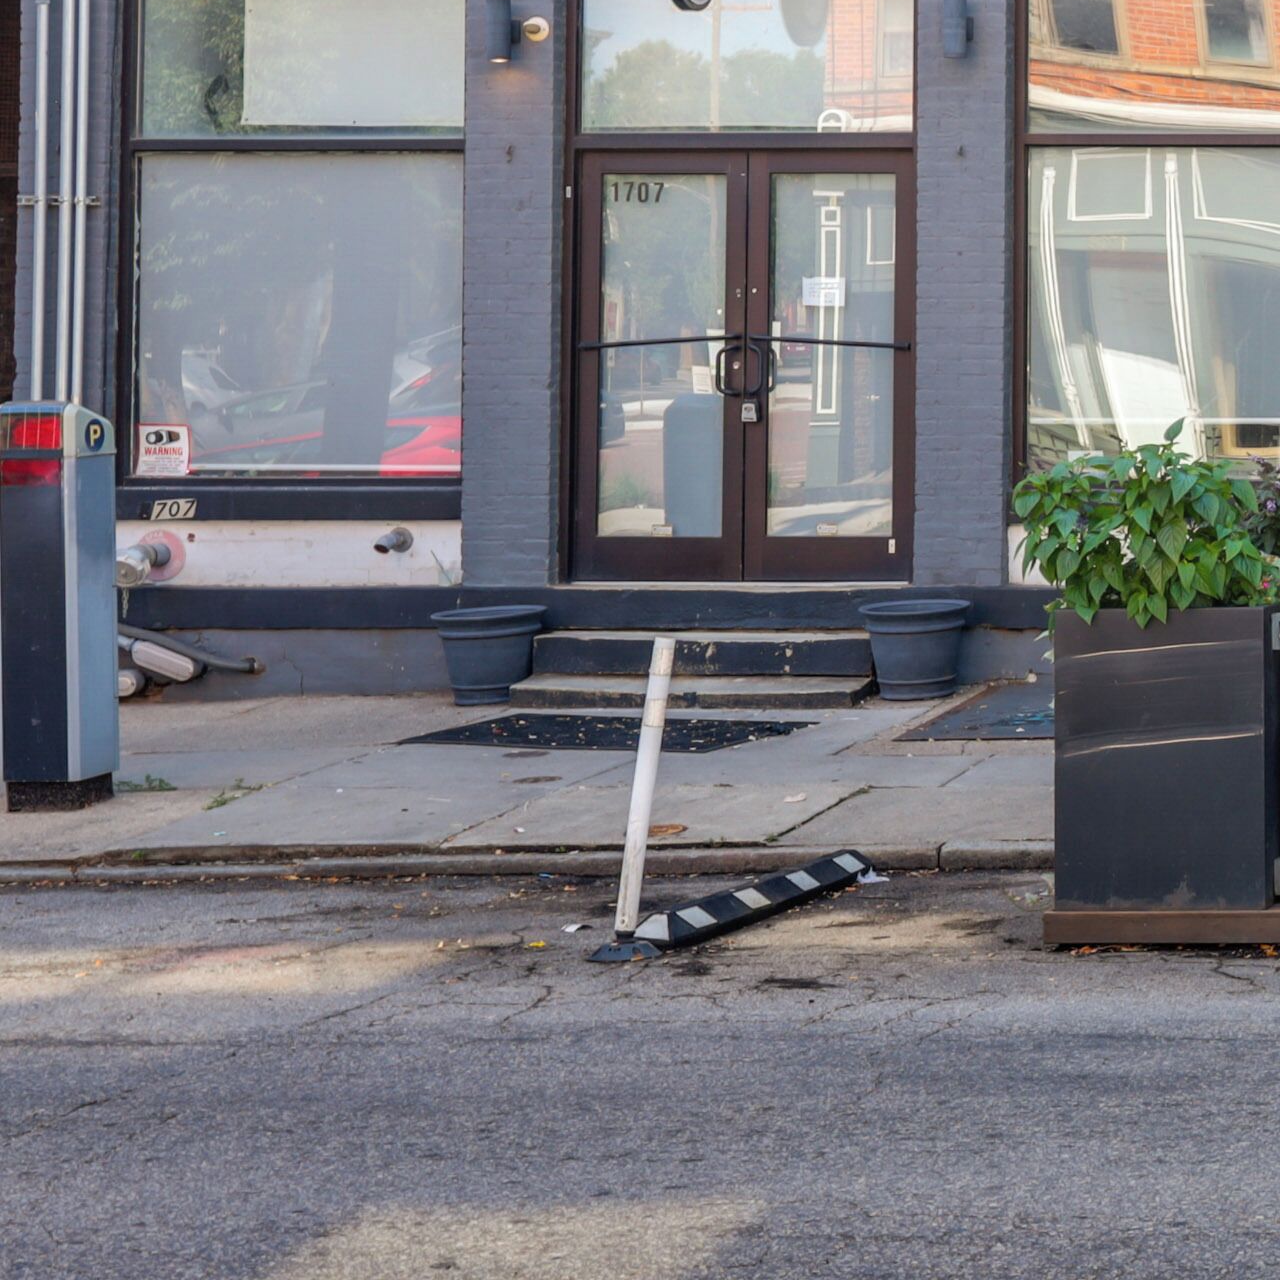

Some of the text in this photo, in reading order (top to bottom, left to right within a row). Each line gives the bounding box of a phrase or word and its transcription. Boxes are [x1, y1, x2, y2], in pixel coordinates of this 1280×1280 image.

[611, 181, 665, 204] 1707
[89, 424, 102, 448] P
[144, 446, 184, 457] WARNING
[154, 499, 196, 519] 707
